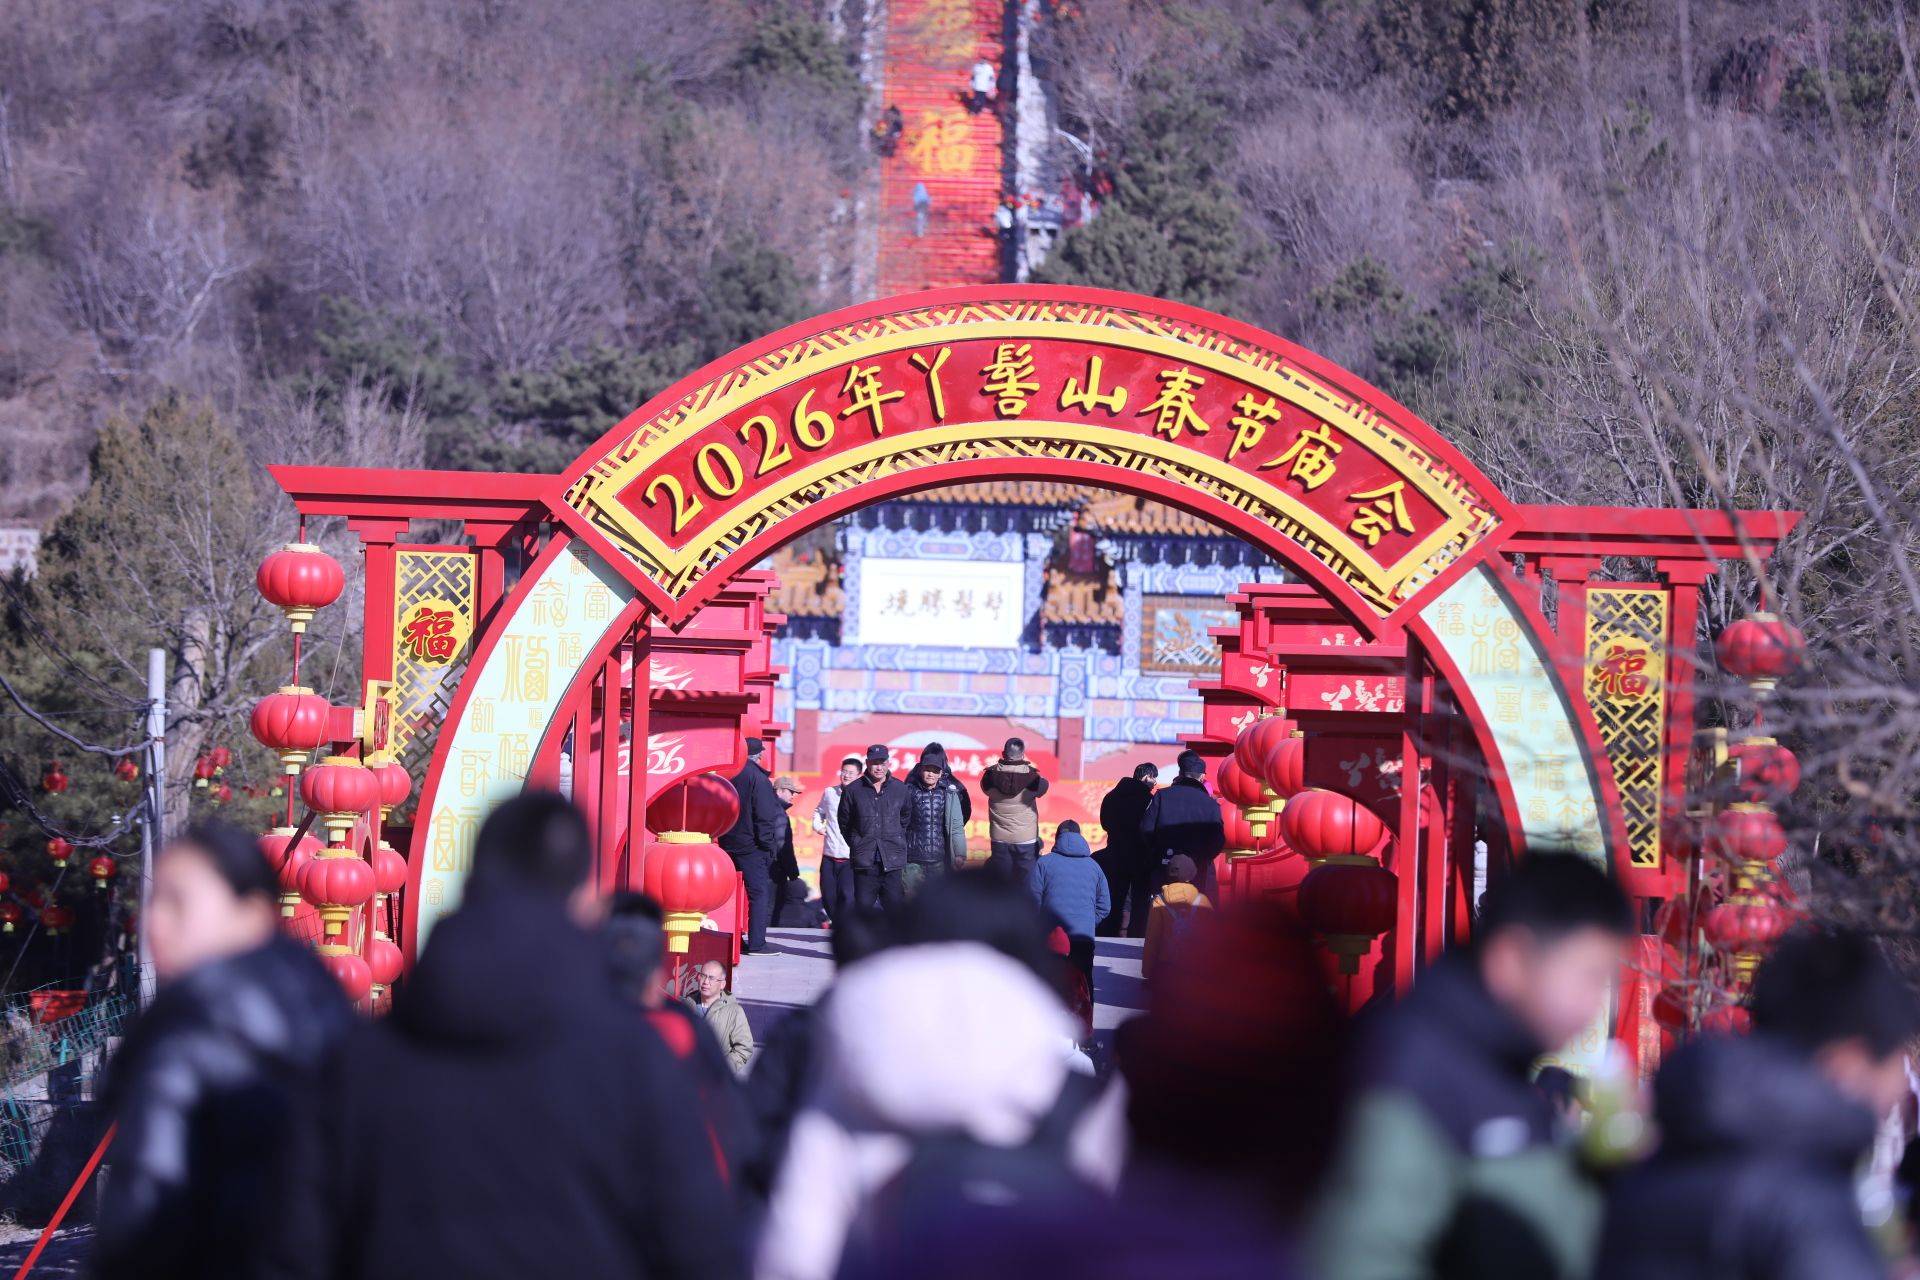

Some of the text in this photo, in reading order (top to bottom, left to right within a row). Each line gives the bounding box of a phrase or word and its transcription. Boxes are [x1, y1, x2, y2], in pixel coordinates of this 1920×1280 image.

[644, 342, 1416, 546] 2026年丫髻山春节庙会
[405, 607, 457, 659] 福
[1597, 645, 1649, 696] 福
[617, 743, 686, 776] 226
